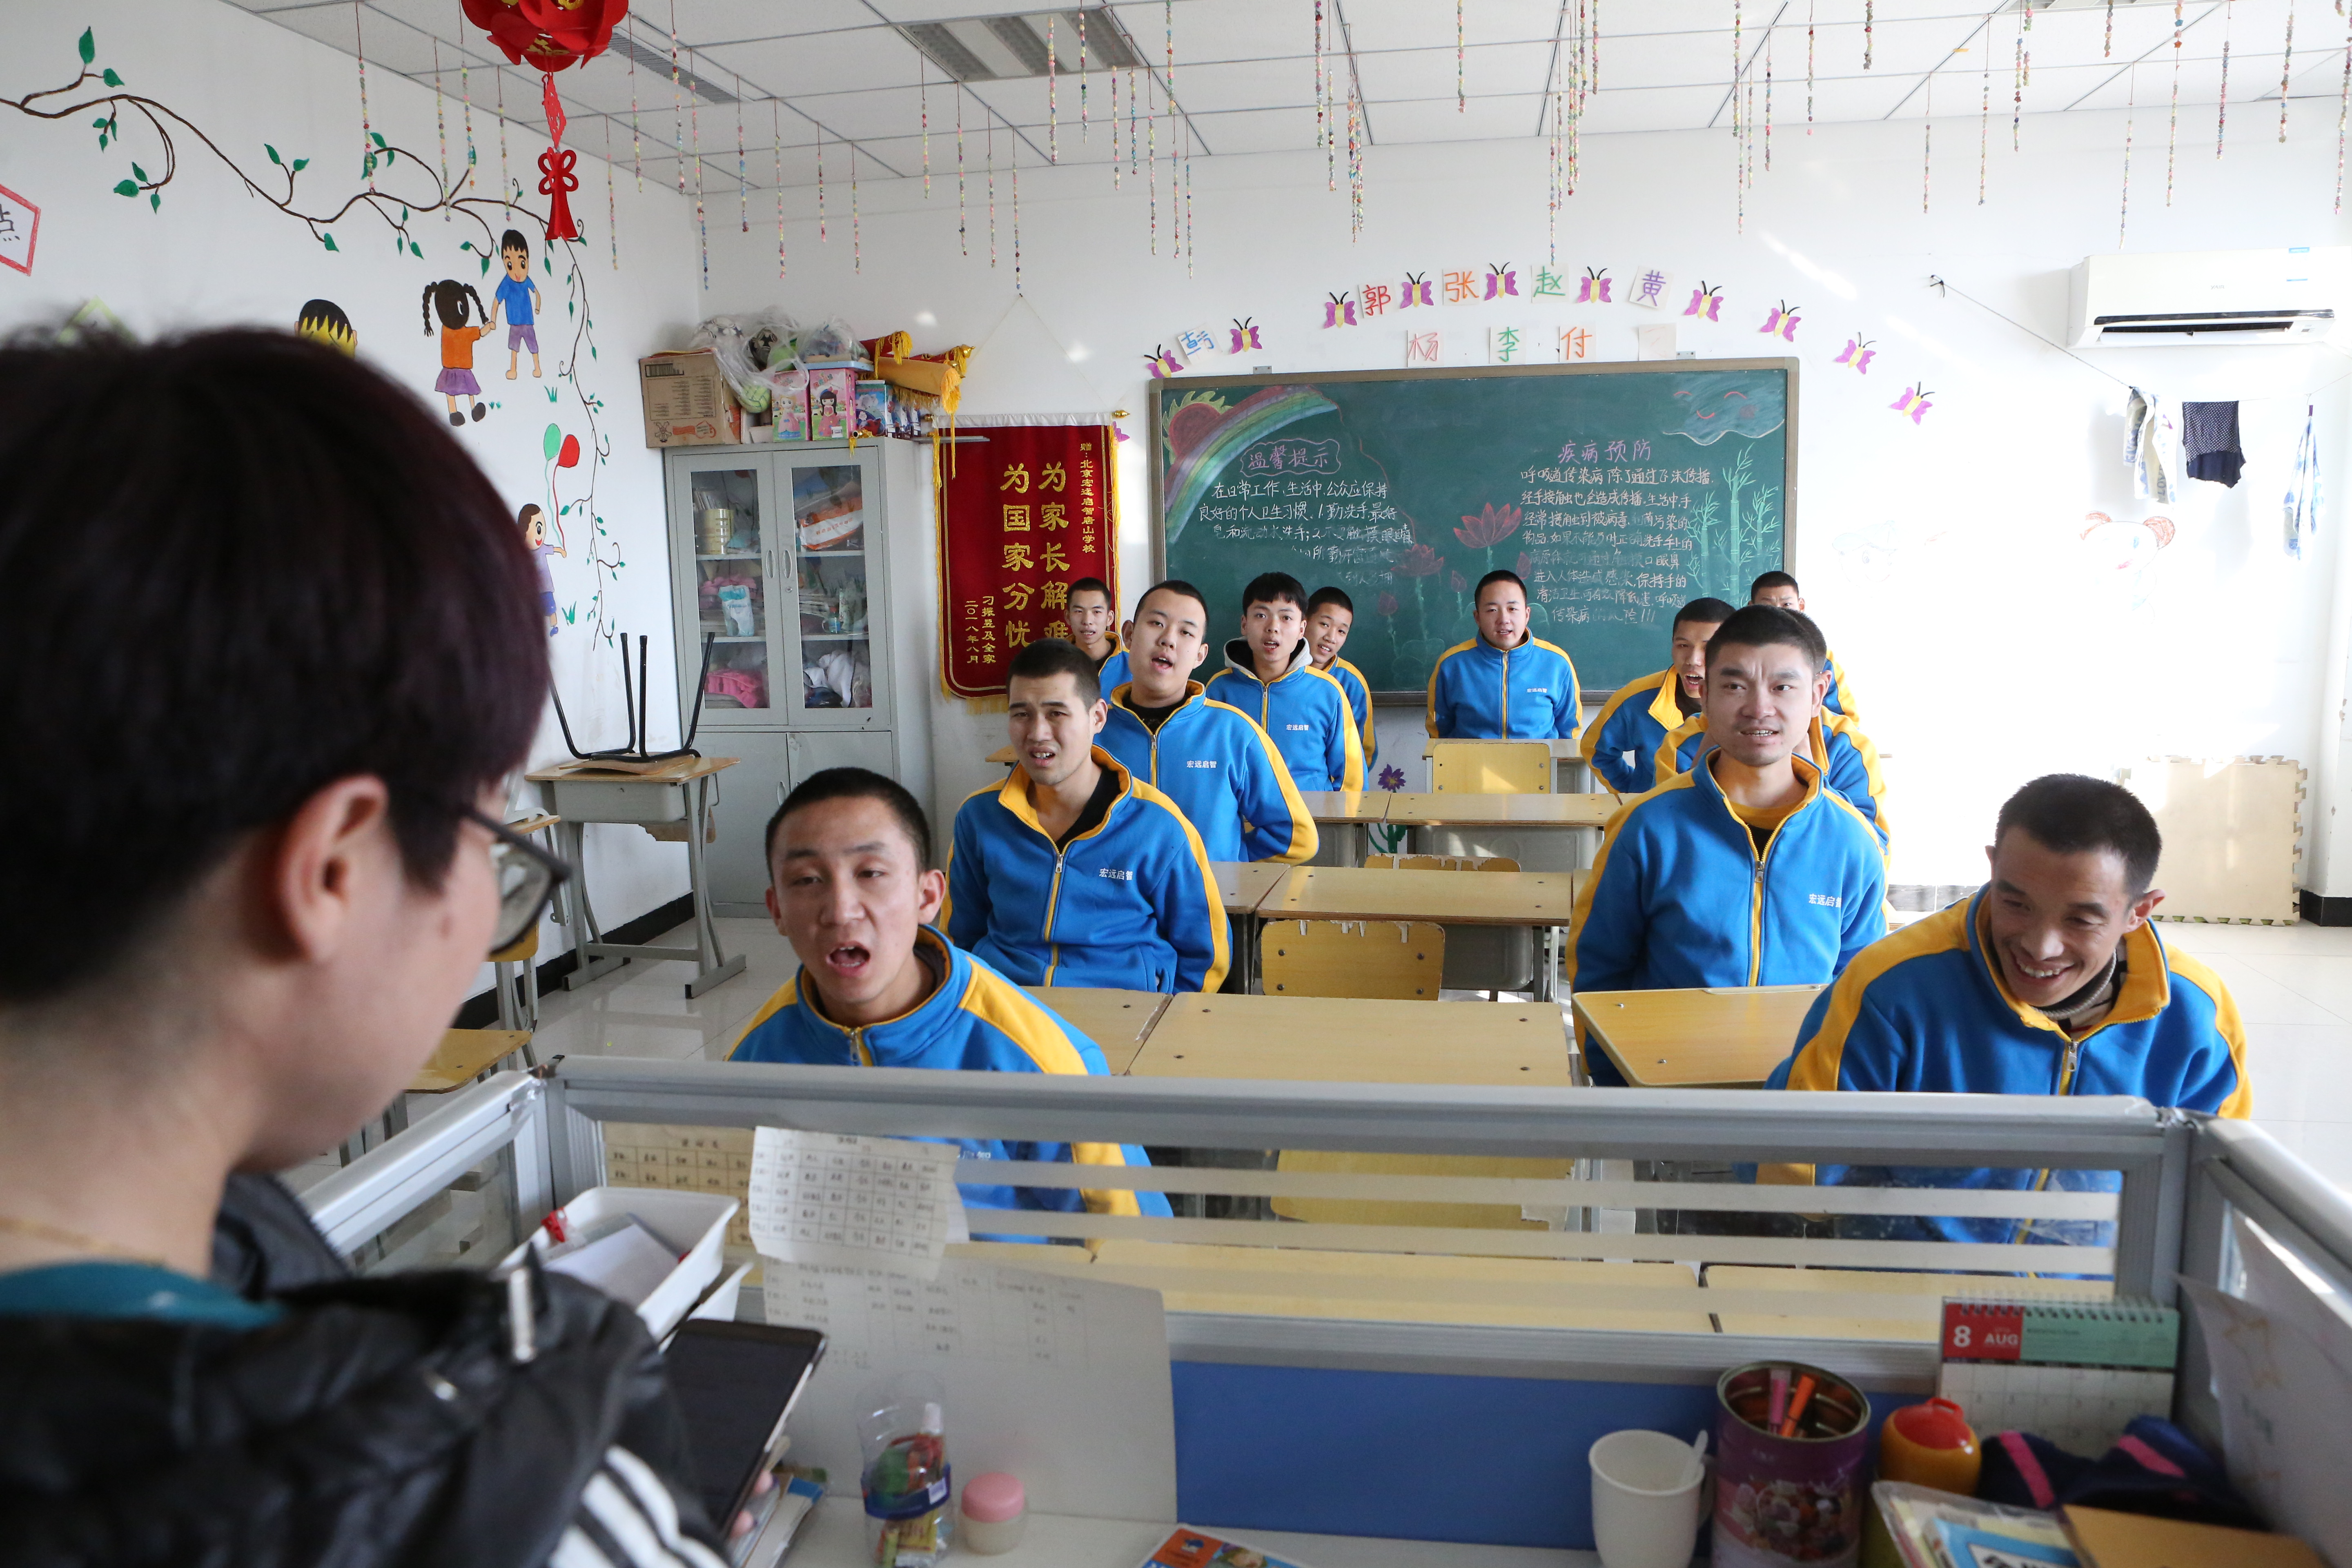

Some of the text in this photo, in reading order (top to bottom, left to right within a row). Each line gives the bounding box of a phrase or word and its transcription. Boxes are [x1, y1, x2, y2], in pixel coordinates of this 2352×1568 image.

[1444, 271, 1479, 302] 张
[1533, 266, 1566, 297] 赵
[1637, 270, 1666, 306] 黄
[1363, 284, 1391, 316] 郭
[1408, 332, 1439, 361] 杨
[1498, 327, 1519, 362] 李
[1561, 327, 1593, 360] 付
[1248, 445, 1328, 470] 温馨提示
[1558, 439, 1651, 464] 疾病预防
[1000, 462, 1036, 648] 为国家分忧
[1187, 760, 1217, 768] 宏远启智
[1099, 868, 1133, 881] 宏远启智
[1953, 1325, 2018, 1348] 8 AUG
